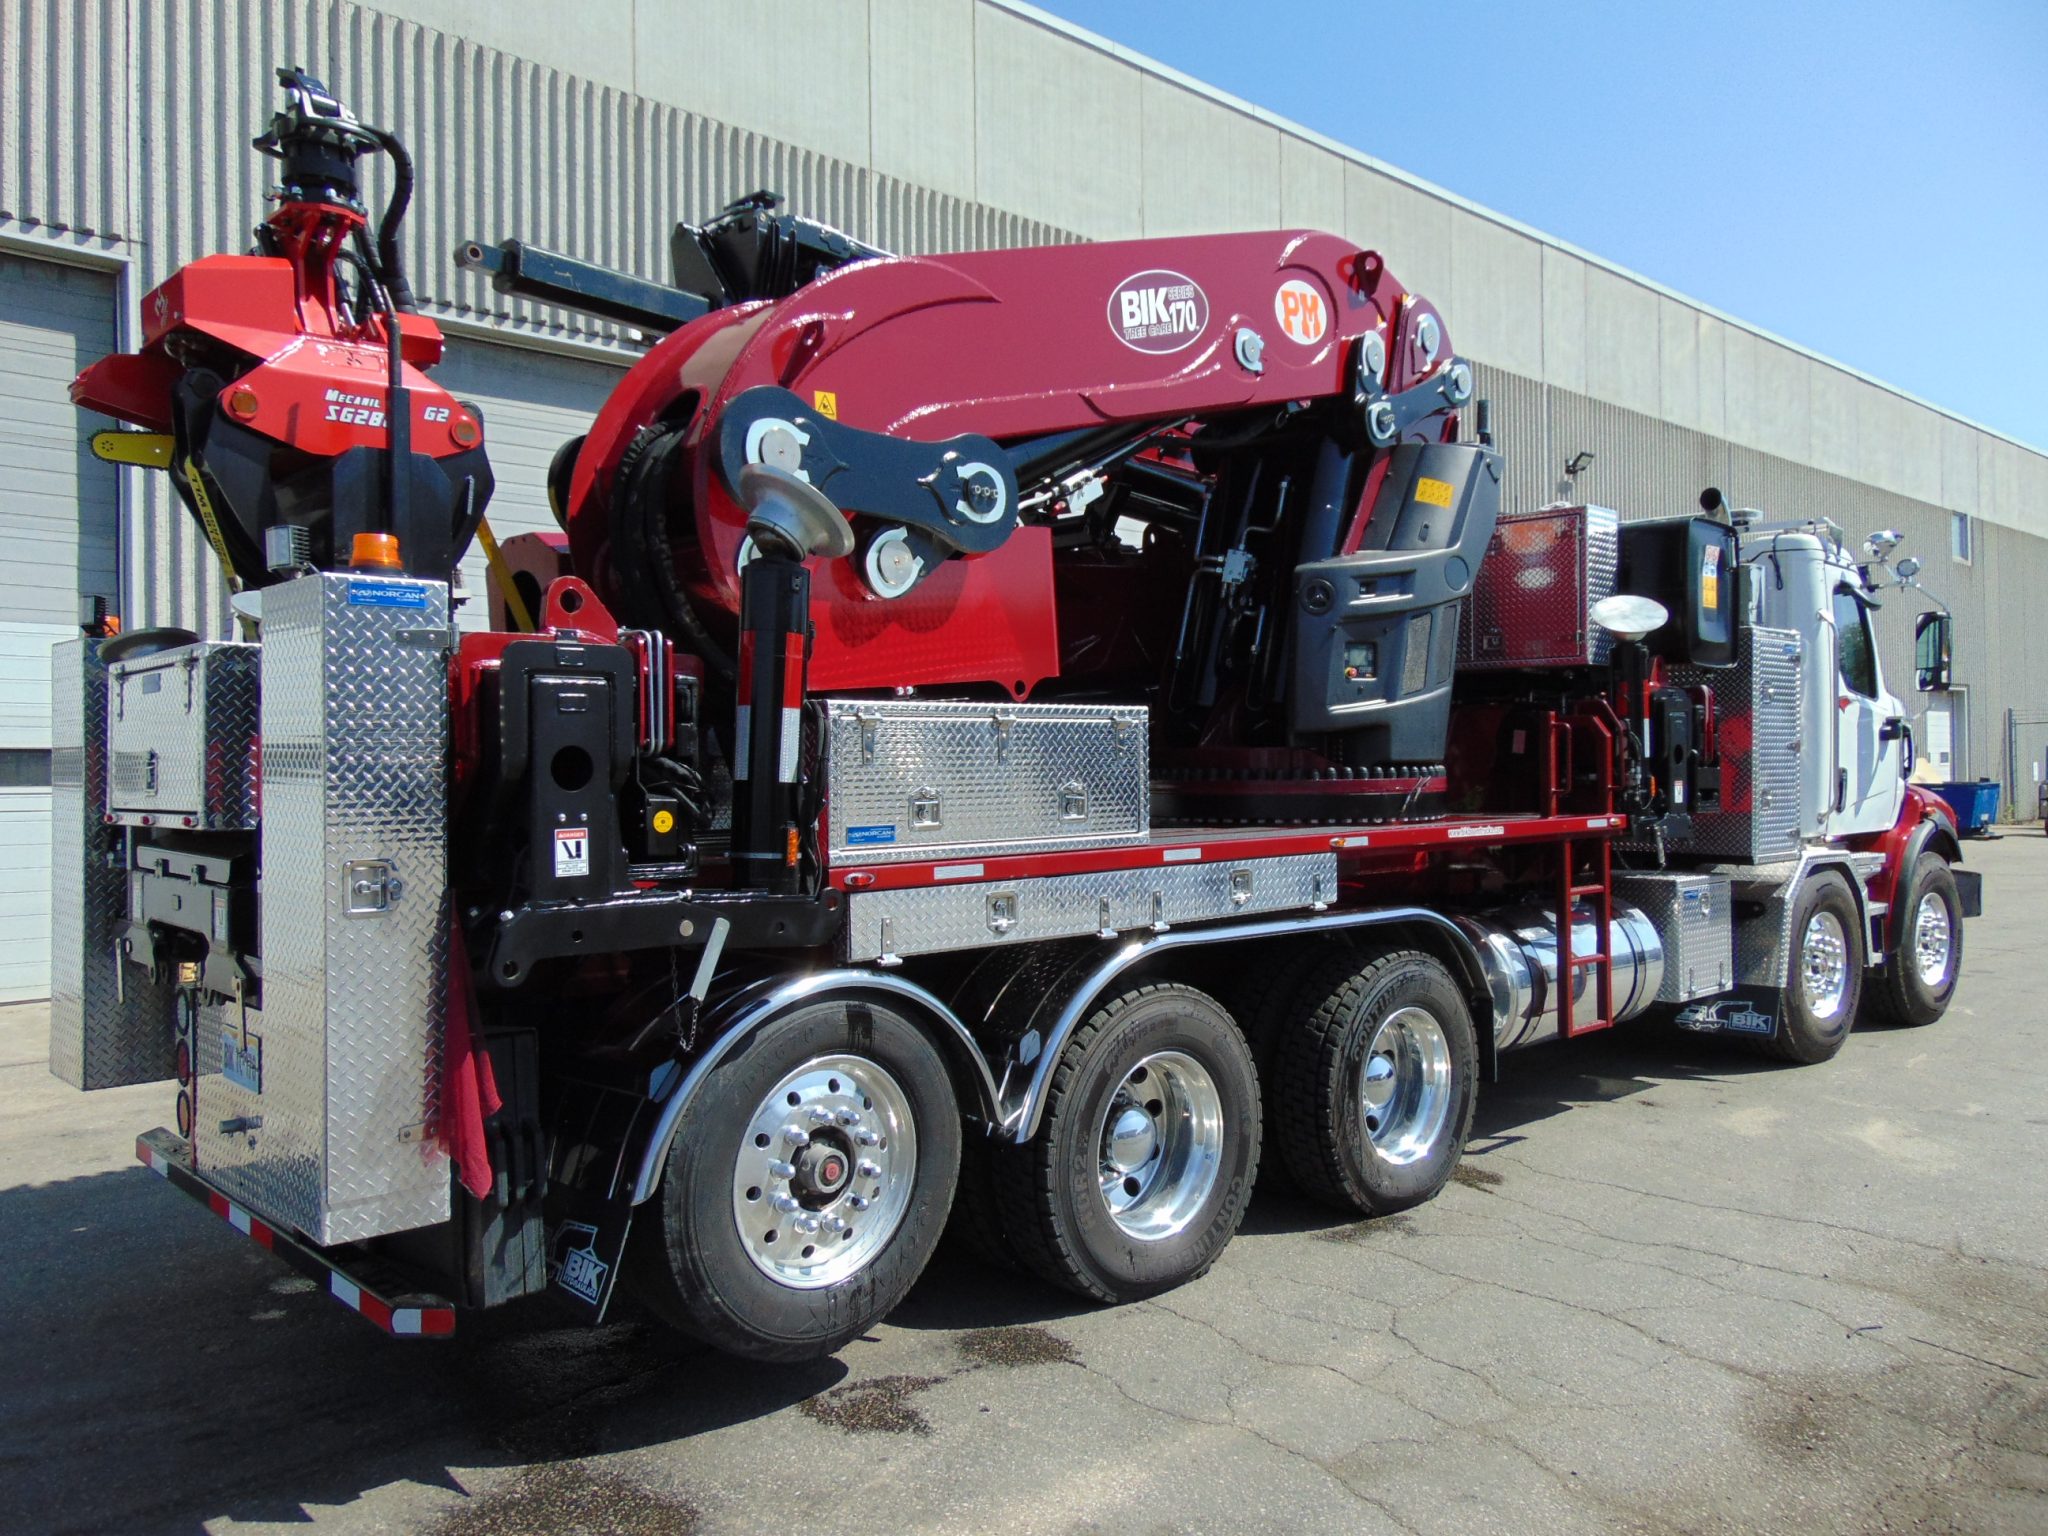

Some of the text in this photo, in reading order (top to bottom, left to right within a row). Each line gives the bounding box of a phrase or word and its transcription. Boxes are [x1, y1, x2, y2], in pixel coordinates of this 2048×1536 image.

[1167, 284, 1195, 300] SERIES
[1120, 287, 1171, 328] BIK
[1168, 299, 1197, 334] 170
[1281, 290, 1321, 339] PM
[1123, 322, 1172, 341] TREE CARE
[325, 405, 387, 428] SG28
[424, 406, 450, 422] G2
[372, 589, 420, 599] NORCAN
[1731, 1014, 1767, 1030] BIK
[563, 1250, 604, 1288] BIK
